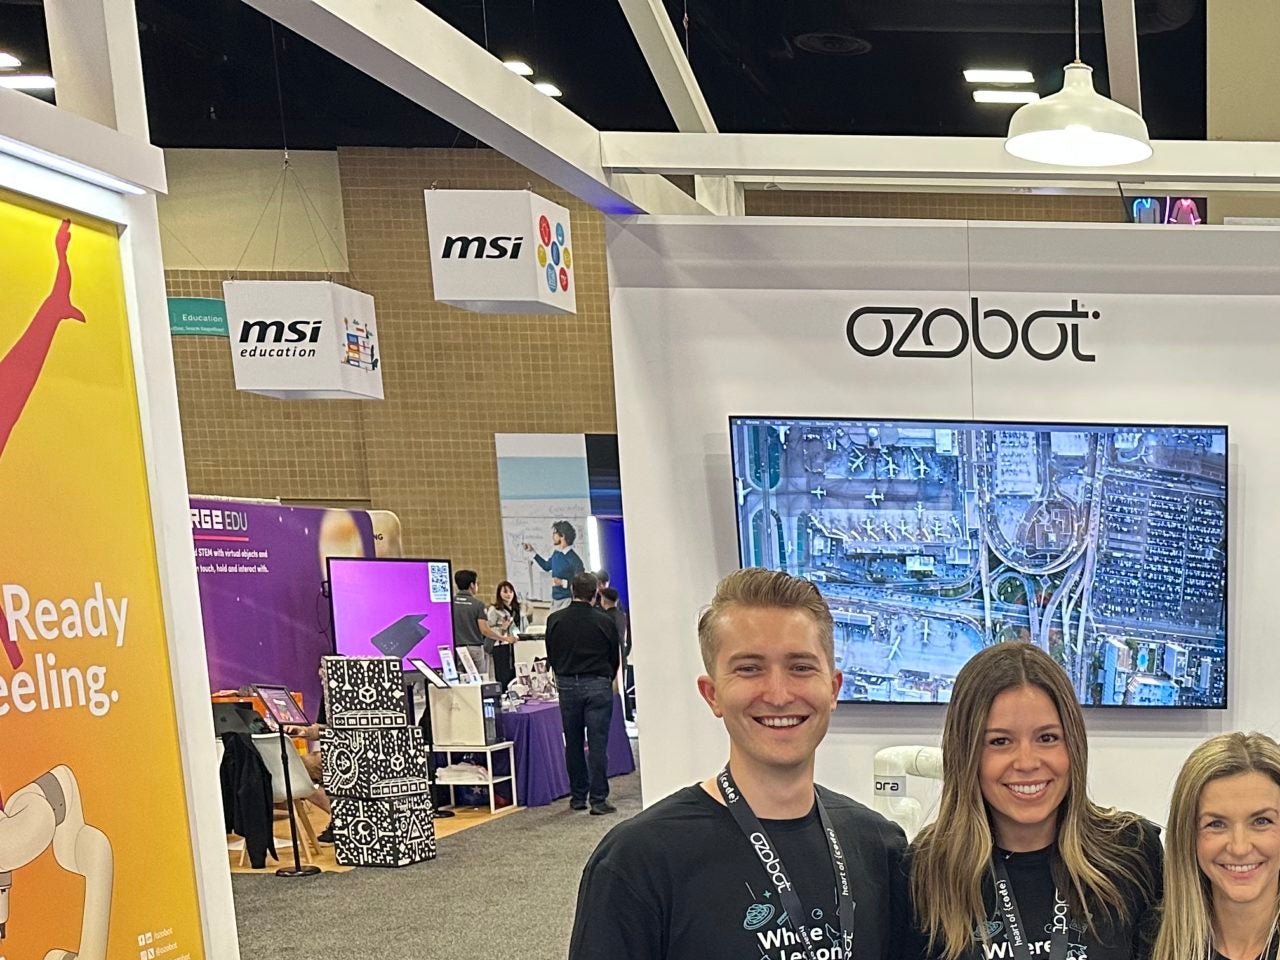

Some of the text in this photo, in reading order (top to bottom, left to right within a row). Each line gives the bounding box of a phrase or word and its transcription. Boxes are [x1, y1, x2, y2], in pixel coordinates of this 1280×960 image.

[441, 235, 524, 259] msi
[182, 313, 223, 323] Education
[846, 297, 1101, 362] ozobot
[239, 320, 322, 343] msi
[240, 346, 316, 358] education
[224, 510, 248, 531] EDU
[198, 547, 213, 557] STEM
[213, 548, 224, 557] with
[2, 581, 128, 647] Ready
[875, 781, 899, 792] ora
[750, 831, 792, 894] ozobot
[757, 926, 823, 950] Whe
